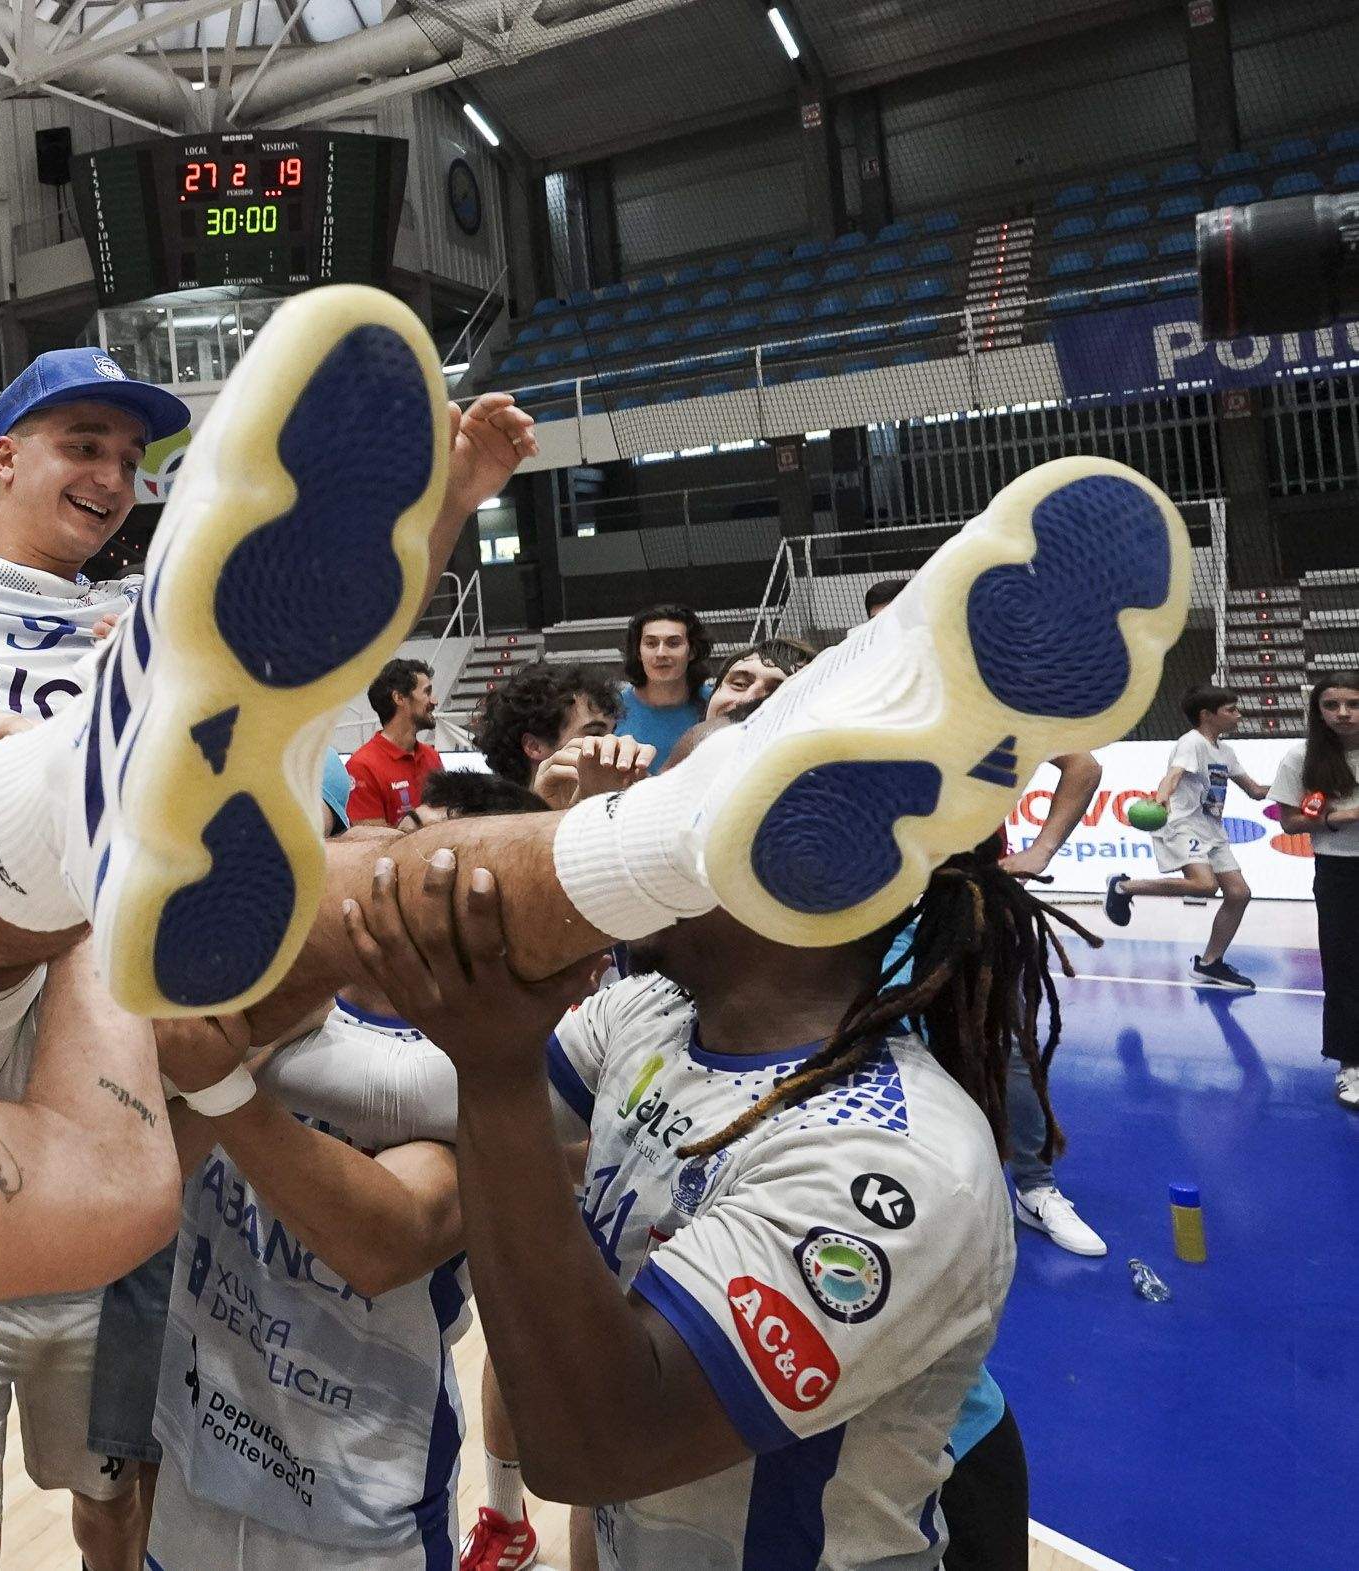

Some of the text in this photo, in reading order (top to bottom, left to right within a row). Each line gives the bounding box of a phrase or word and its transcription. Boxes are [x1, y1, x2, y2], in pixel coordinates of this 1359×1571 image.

[222, 134, 253, 142] MONDO
[185, 146, 208, 156] LOCAL
[328, 141, 334, 152] E
[328, 153, 334, 162] 4
[279, 158, 301, 186] 19
[328, 163, 334, 172] 5
[185, 163, 217, 191] 27
[232, 163, 246, 186] 2
[327, 173, 333, 183] 6
[327, 184, 333, 193] 7
[326, 194, 332, 204] 8
[326, 204, 332, 214] 9
[98, 220, 104, 230] 9
[206, 205, 277, 236] 30:00
[323, 216, 334, 225] 10
[323, 226, 333, 236] 11
[322, 236, 333, 246] 12
[322, 247, 332, 257] 13
[321, 268, 331, 278] 15
[6, 615, 77, 651] 9
[1022, 836, 1153, 862] Dspain
[1189, 838, 1201, 852] 2
[861, 1177, 905, 1225] K
[210, 1292, 244, 1336] DE
[729, 1288, 832, 1403] AC&C
